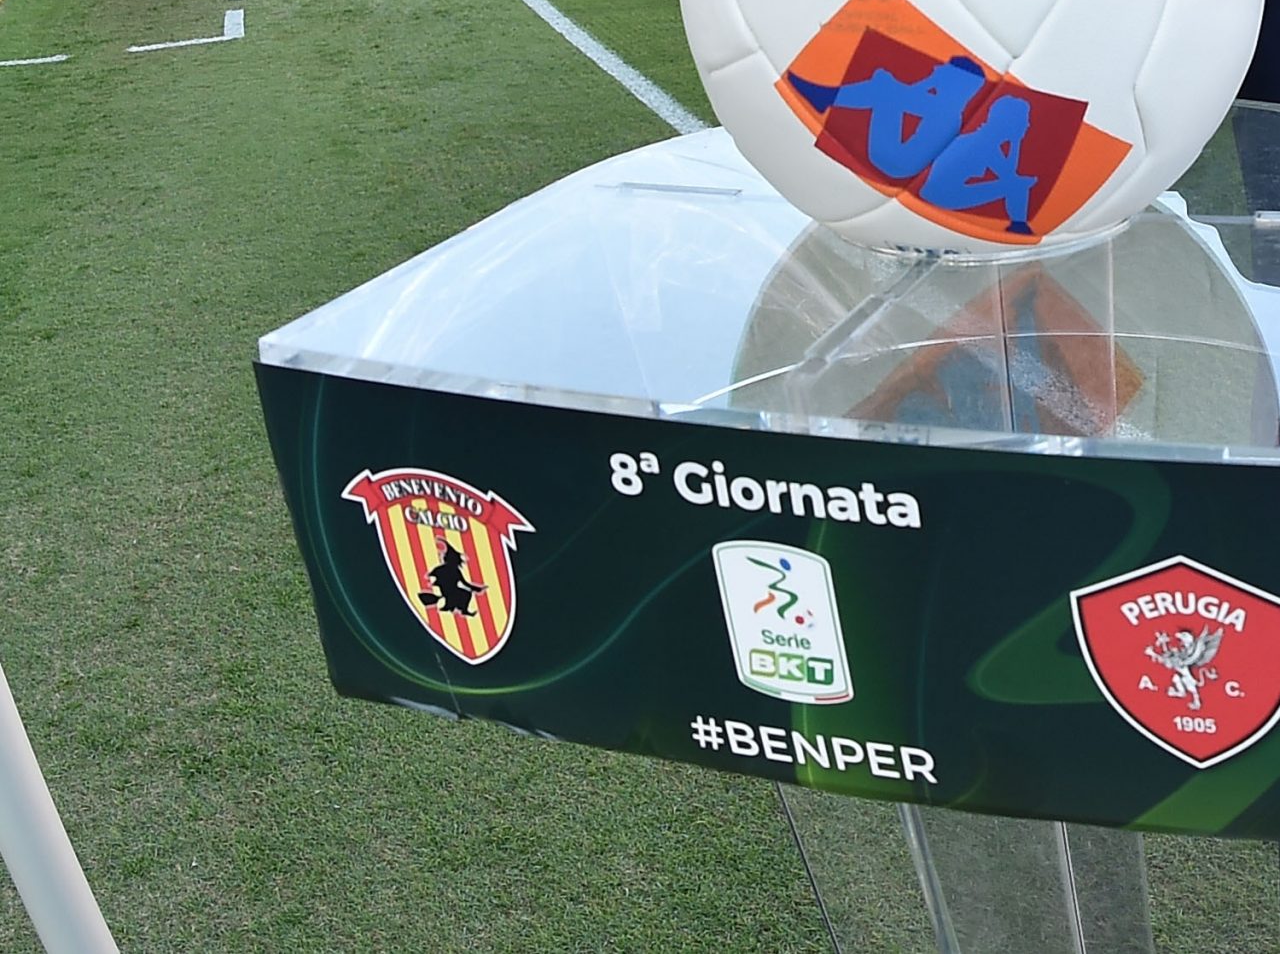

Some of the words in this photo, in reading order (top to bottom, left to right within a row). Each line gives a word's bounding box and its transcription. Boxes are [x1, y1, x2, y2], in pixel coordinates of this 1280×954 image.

[381, 478, 484, 517] BENEVENTO
[673, 460, 922, 528] Giornata
[404, 505, 469, 533] CALCIO
[1120, 591, 1247, 633] PERUGIA
[761, 629, 812, 650] Serie
[750, 649, 834, 685] BKT
[1173, 715, 1217, 734] 1905
[690, 715, 938, 784] #BENPER
